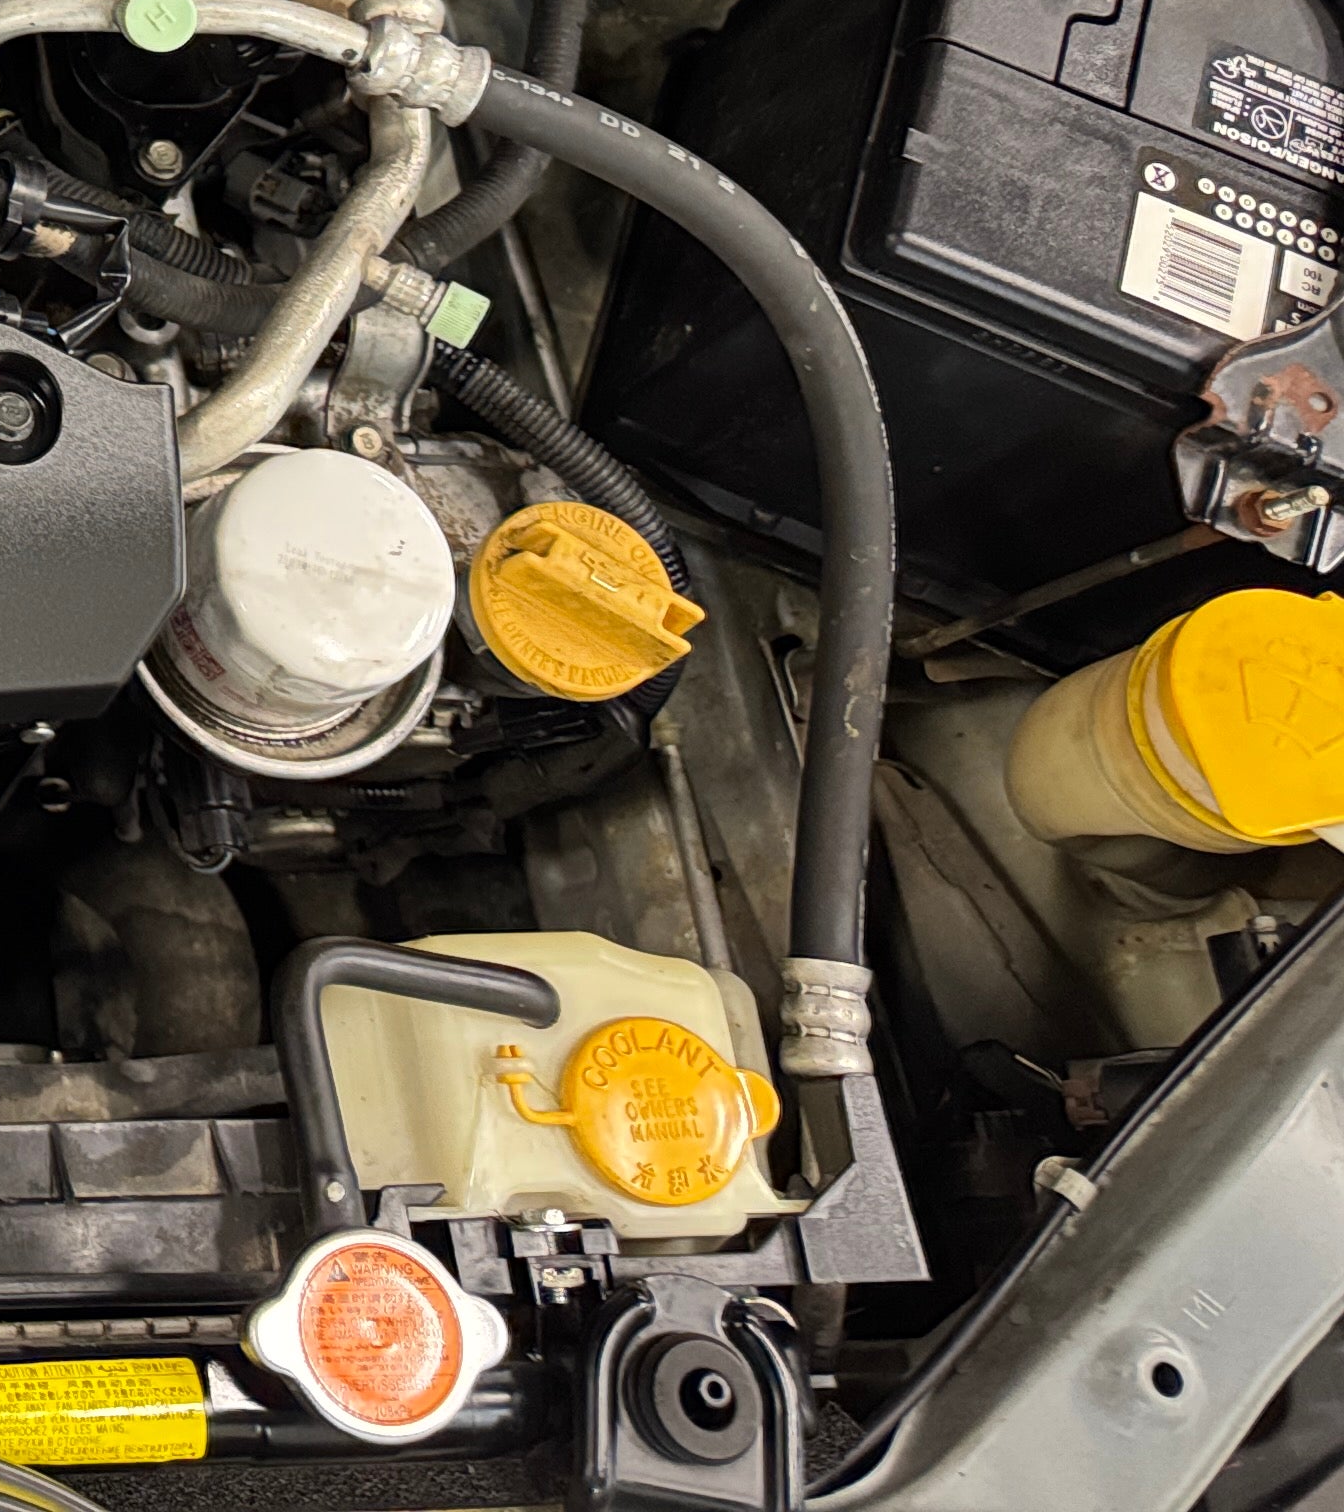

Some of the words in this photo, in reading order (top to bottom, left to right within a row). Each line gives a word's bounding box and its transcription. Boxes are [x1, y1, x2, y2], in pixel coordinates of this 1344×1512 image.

[144, 2, 177, 33] H
[599, 111, 641, 138] DD
[1303, 267, 1323, 283] 100
[582, 1027, 721, 1090] COOLANT
[631, 1077, 671, 1099] SEE
[625, 1096, 699, 1123] OWNERS
[630, 1119, 705, 1144] MANUAL
[350, 1263, 414, 1275] WARNING
[42, 1364, 93, 1377] ATTENTION
[52, 1425, 70, 1436] PAS
[75, 1424, 93, 1435] LES
